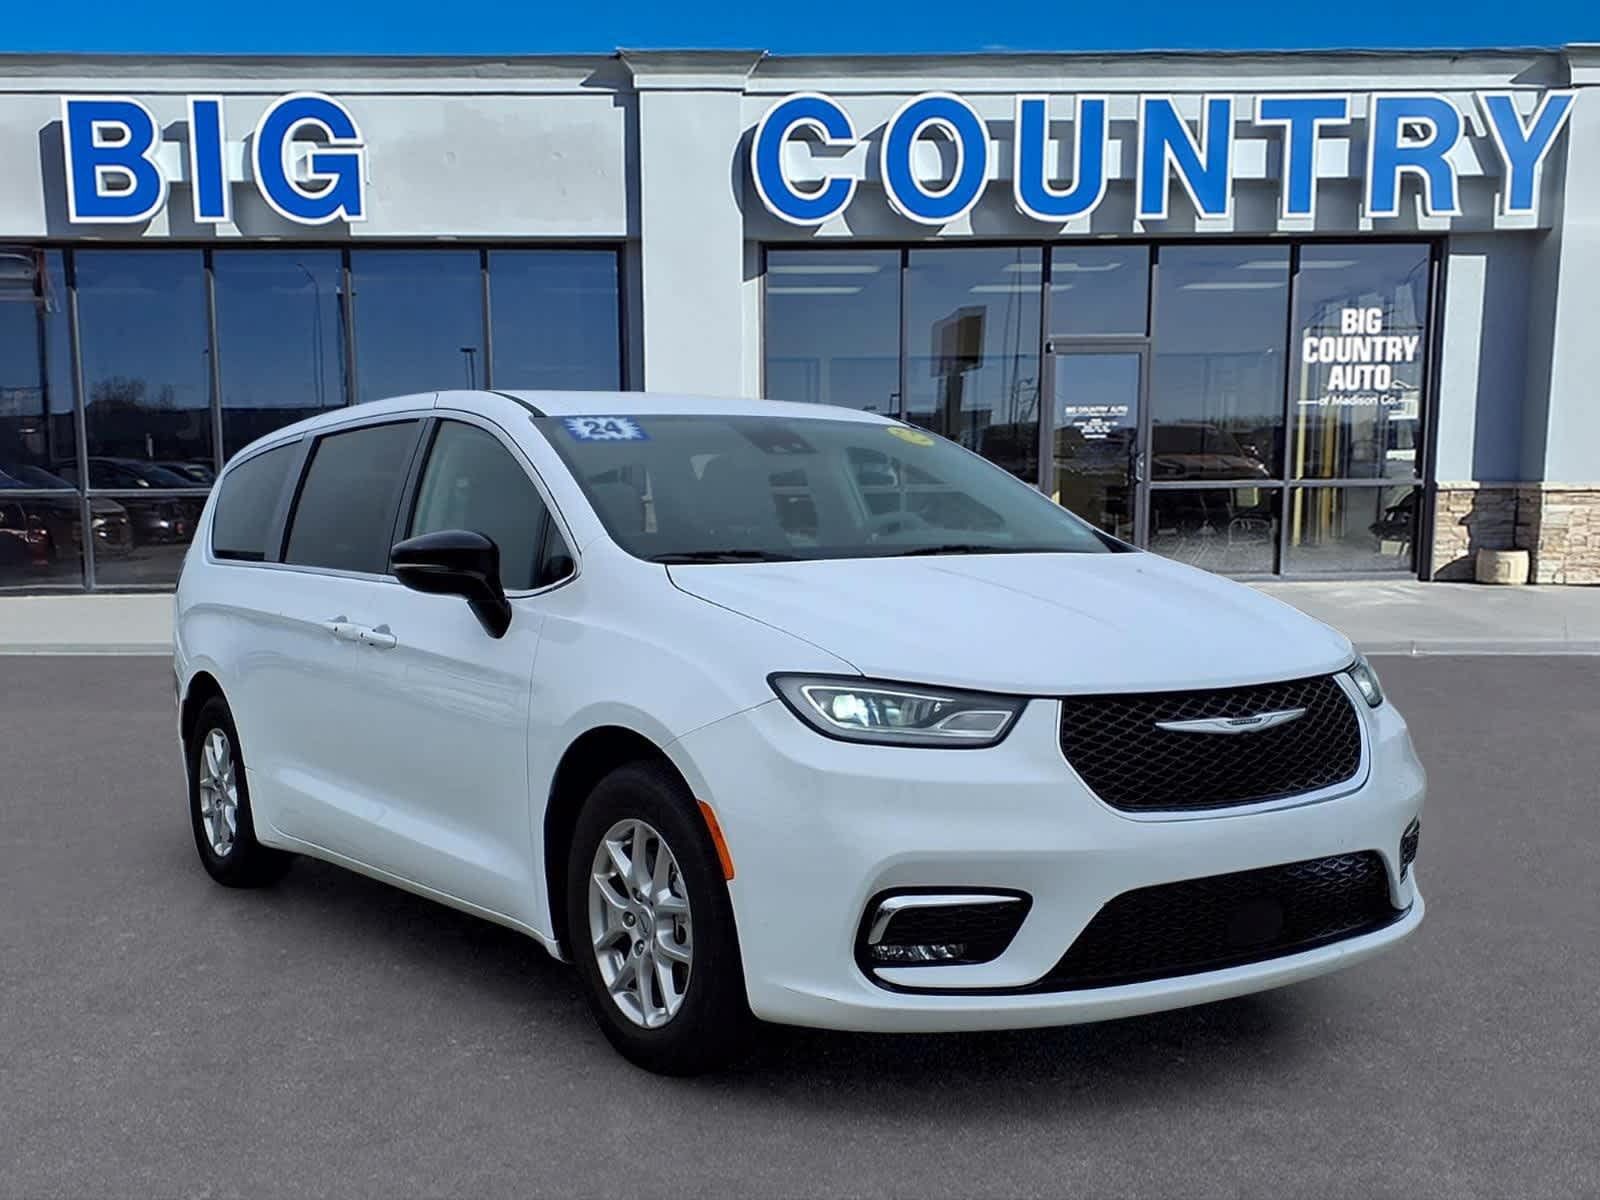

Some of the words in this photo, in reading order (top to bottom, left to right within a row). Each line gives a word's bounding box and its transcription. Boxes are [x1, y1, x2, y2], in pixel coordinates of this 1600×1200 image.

[60, 91, 367, 225] BIG
[750, 91, 1577, 226] COUNTRY
[1341, 308, 1382, 334] BIG
[1302, 336, 1419, 363] COUNTRY
[1327, 365, 1391, 391] AUTO
[1319, 396, 1329, 406] of
[1332, 395, 1378, 405] Madison
[583, 421, 622, 435] 24
